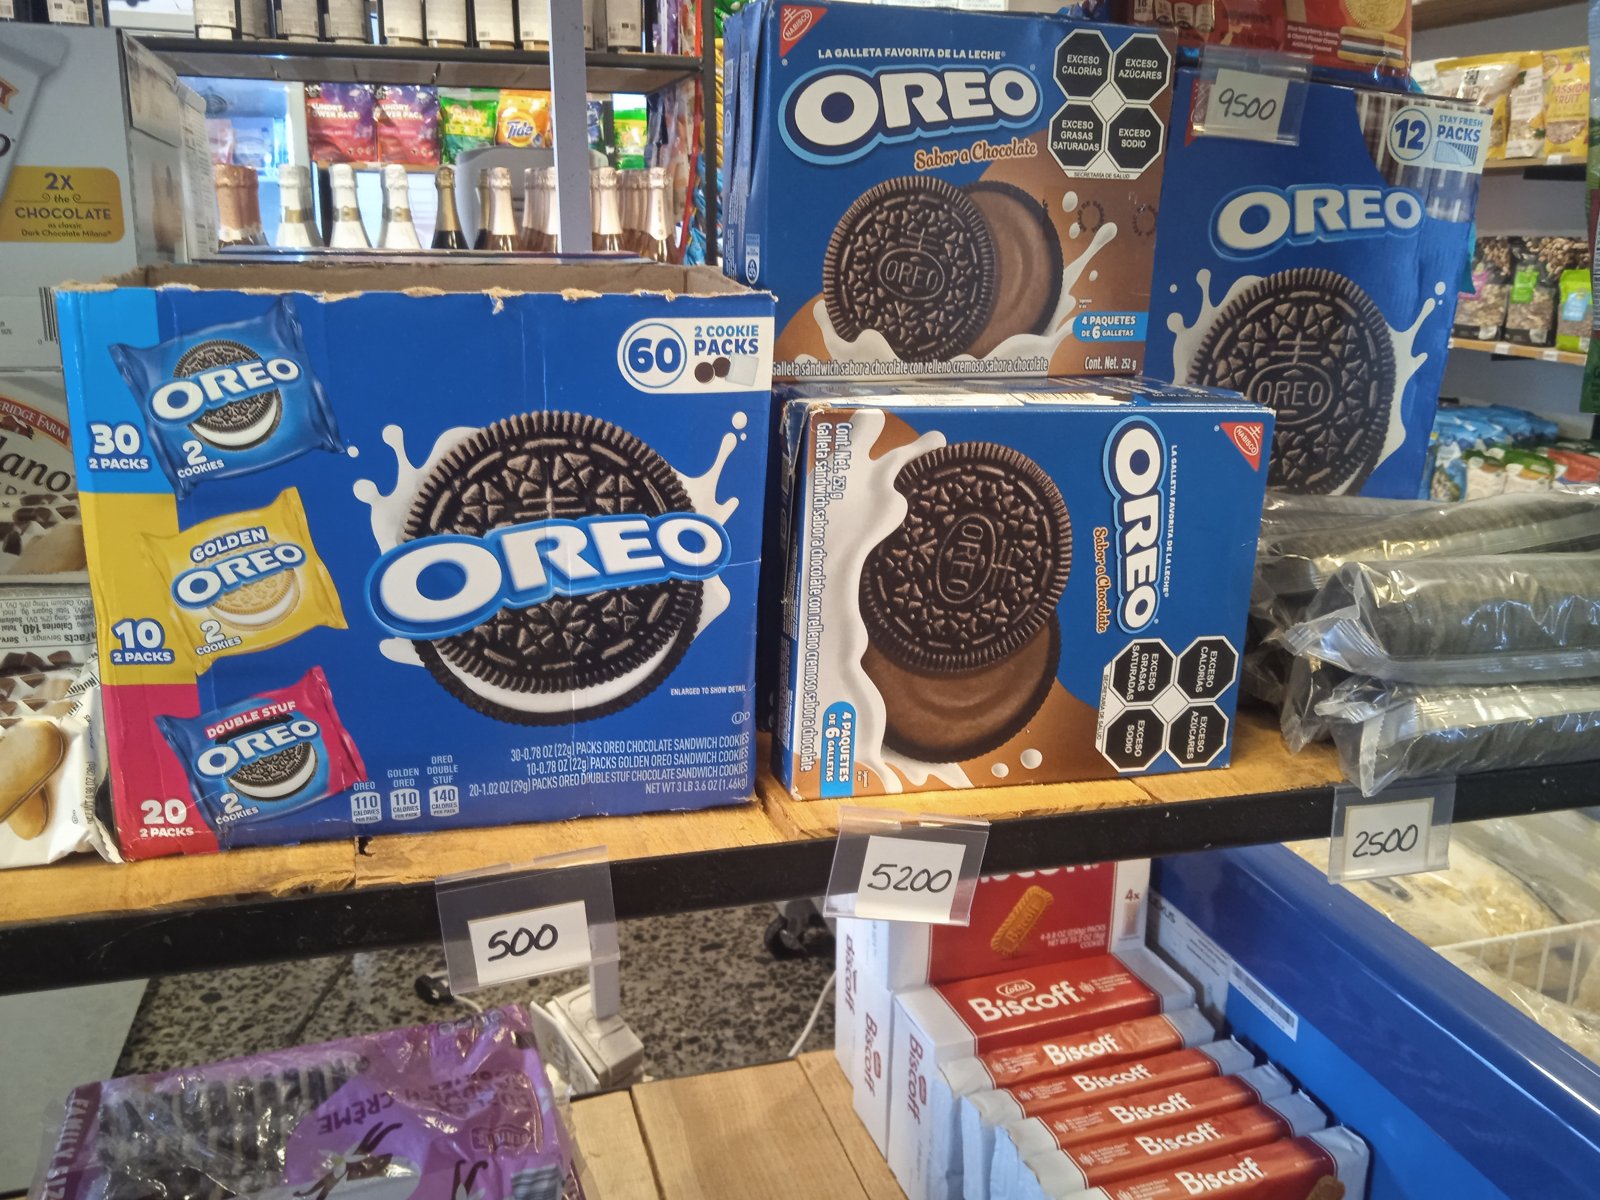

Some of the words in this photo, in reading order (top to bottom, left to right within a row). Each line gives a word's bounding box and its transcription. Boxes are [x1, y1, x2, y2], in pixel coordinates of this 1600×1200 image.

[785, 12, 810, 38] NABISCO
[818, 49, 832, 59] LA
[834, 48, 882, 58] GALLETA
[884, 48, 935, 58] FAVORITA
[938, 49, 951, 58] DE
[953, 49, 966, 59] LA
[1066, 54, 1100, 64] EXCESO
[1125, 58, 1158, 68] EXCESO
[1061, 65, 1102, 76] CALORÍAS
[1118, 69, 1162, 80] AZÚCARES
[794, 70, 1037, 147] OREO
[1219, 88, 1276, 120] 9500
[507, 122, 533, 139] Tide
[1062, 120, 1093, 129] EXCESO
[1118, 128, 1151, 137] EXCESO
[1437, 125, 1480, 142] PACKS
[1439, 114, 1457, 124] STAY
[1459, 116, 1483, 127] FRESH
[1052, 141, 1100, 151] SATURADAS
[1060, 130, 1093, 140] GRASAS
[1121, 139, 1146, 148] SODIO
[1395, 119, 1426, 150] 12
[916, 148, 957, 169] Sabor
[972, 138, 1037, 160] Chocolate
[44, 172, 74, 190] 2X
[54, 194, 70, 203] the
[14, 207, 111, 220] CHOCOLATE
[1217, 189, 1422, 250] OREO
[21, 229, 40, 237] Dark
[41, 229, 81, 237] Chocolate
[886, 260, 938, 290] OREO
[694, 326, 703, 337] 2
[706, 325, 759, 337] COOKIE
[1090, 316, 1136, 326] PAQUETES
[628, 338, 681, 373] 60
[694, 338, 759, 356] PACKS
[840, 360, 864, 375] sabor
[871, 359, 908, 375] chocolate
[985, 357, 1007, 373] sabor
[1012, 356, 1048, 372] chocolate
[1085, 356, 1102, 371] Cont.
[1104, 356, 1119, 370] Net.
[152, 358, 299, 419] OREO
[1257, 381, 1323, 406] OREO
[37, 414, 65, 440] FARM
[90, 424, 140, 455] 30
[816, 422, 832, 459] Galleta
[835, 423, 853, 449] Cont.
[182, 440, 207, 465] 2
[1237, 429, 1257, 454] NABISCO
[100, 458, 149, 470] PACKS
[177, 459, 225, 478] COOKIES
[832, 450, 851, 473] Net.
[813, 459, 831, 508] sándwich
[811, 509, 828, 538] sabor
[1115, 428, 1161, 628] OREO
[1167, 497, 1176, 539] FAVORITA
[192, 527, 268, 562] GOLDEN
[1094, 528, 1107, 565] Sabor
[177, 545, 302, 603] OREO
[380, 518, 722, 622] OREO
[809, 548, 827, 596] chocolate
[1097, 576, 1110, 632] Chocolate
[42, 622, 73, 630] Calories
[114, 620, 162, 648] 10
[200, 619, 226, 644] 2
[806, 615, 824, 650] relleno
[125, 652, 172, 662] PACKS
[196, 636, 242, 655] COOKIES
[804, 650, 819, 692] cremoso
[1127, 645, 1140, 701] SATURADAS
[1137, 653, 1149, 691] GRASAS
[1148, 653, 1159, 691] EXCESO
[1195, 646, 1208, 693] CALORÍAS
[1206, 651, 1217, 687] EXCESO
[671, 688, 700, 696] ENLARGED
[803, 692, 820, 719] sabor
[206, 709, 261, 739] DOUBLE
[262, 701, 296, 718] STUF
[511, 746, 541, 762] 30-0.78
[576, 742, 602, 754] PACKS
[603, 740, 625, 754] OREO
[626, 739, 672, 753] CHOCOLATE
[674, 737, 717, 751] SANDWICH
[719, 731, 749, 748] COOKIES
[1125, 724, 1135, 753] SODIO
[1134, 720, 1145, 757] EXCESO
[1187, 711, 1199, 759] AZÚCARES
[1197, 716, 1208, 752] EXCESO
[197, 720, 318, 776] OREO
[431, 755, 453, 764] OREO
[527, 761, 556, 776] 10-0.78
[590, 756, 616, 770] PACKS
[618, 755, 649, 769] GOLDEN
[651, 753, 672, 767] OREO
[673, 751, 717, 765] SANDWICH
[718, 746, 749, 763] COOKIES
[801, 727, 818, 771] chocolate
[826, 740, 835, 782] GALLETAS
[839, 722, 851, 782] PAQUETES
[387, 768, 419, 778] GOLDEN
[393, 779, 415, 788] OREO
[427, 765, 459, 775] DOUBLE
[433, 775, 453, 784] STUF
[469, 782, 498, 797] 20-1.02
[532, 776, 557, 790] PACKS
[559, 773, 579, 786] OREO
[581, 771, 610, 785] DOUBLE
[611, 770, 631, 783] STUF
[631, 768, 675, 781] CHOCOLATE
[676, 766, 718, 779] SANDWICH
[719, 760, 748, 777] COOKIES
[353, 782, 376, 791] OREO
[394, 791, 417, 806] 110
[433, 789, 456, 803] 140
[645, 782, 660, 794] NET
[662, 781, 676, 793] WT
[140, 799, 186, 824] 20
[215, 806, 259, 825] COOKIES
[220, 793, 243, 814] 2
[353, 808, 380, 817] CALORIES
[354, 795, 378, 809] 110
[392, 805, 419, 813] CALORIES
[150, 826, 194, 837] PACKS
[1352, 824, 1418, 858] 2500
[867, 863, 952, 893] 5200
[487, 923, 558, 962] 500
[968, 980, 1080, 1022] Biscoff
[864, 1012, 877, 1097] Biscoff
[1042, 1033, 1120, 1066] Biscoff
[907, 1033, 923, 1125] Biscoff
[1072, 1064, 1152, 1092] Biscoff
[317, 1090, 395, 1135] CRÈME
[1109, 1092, 1193, 1124] Biscoff
[1135, 1122, 1222, 1156] Biscoff
[1174, 1157, 1265, 1195] Biscoff
